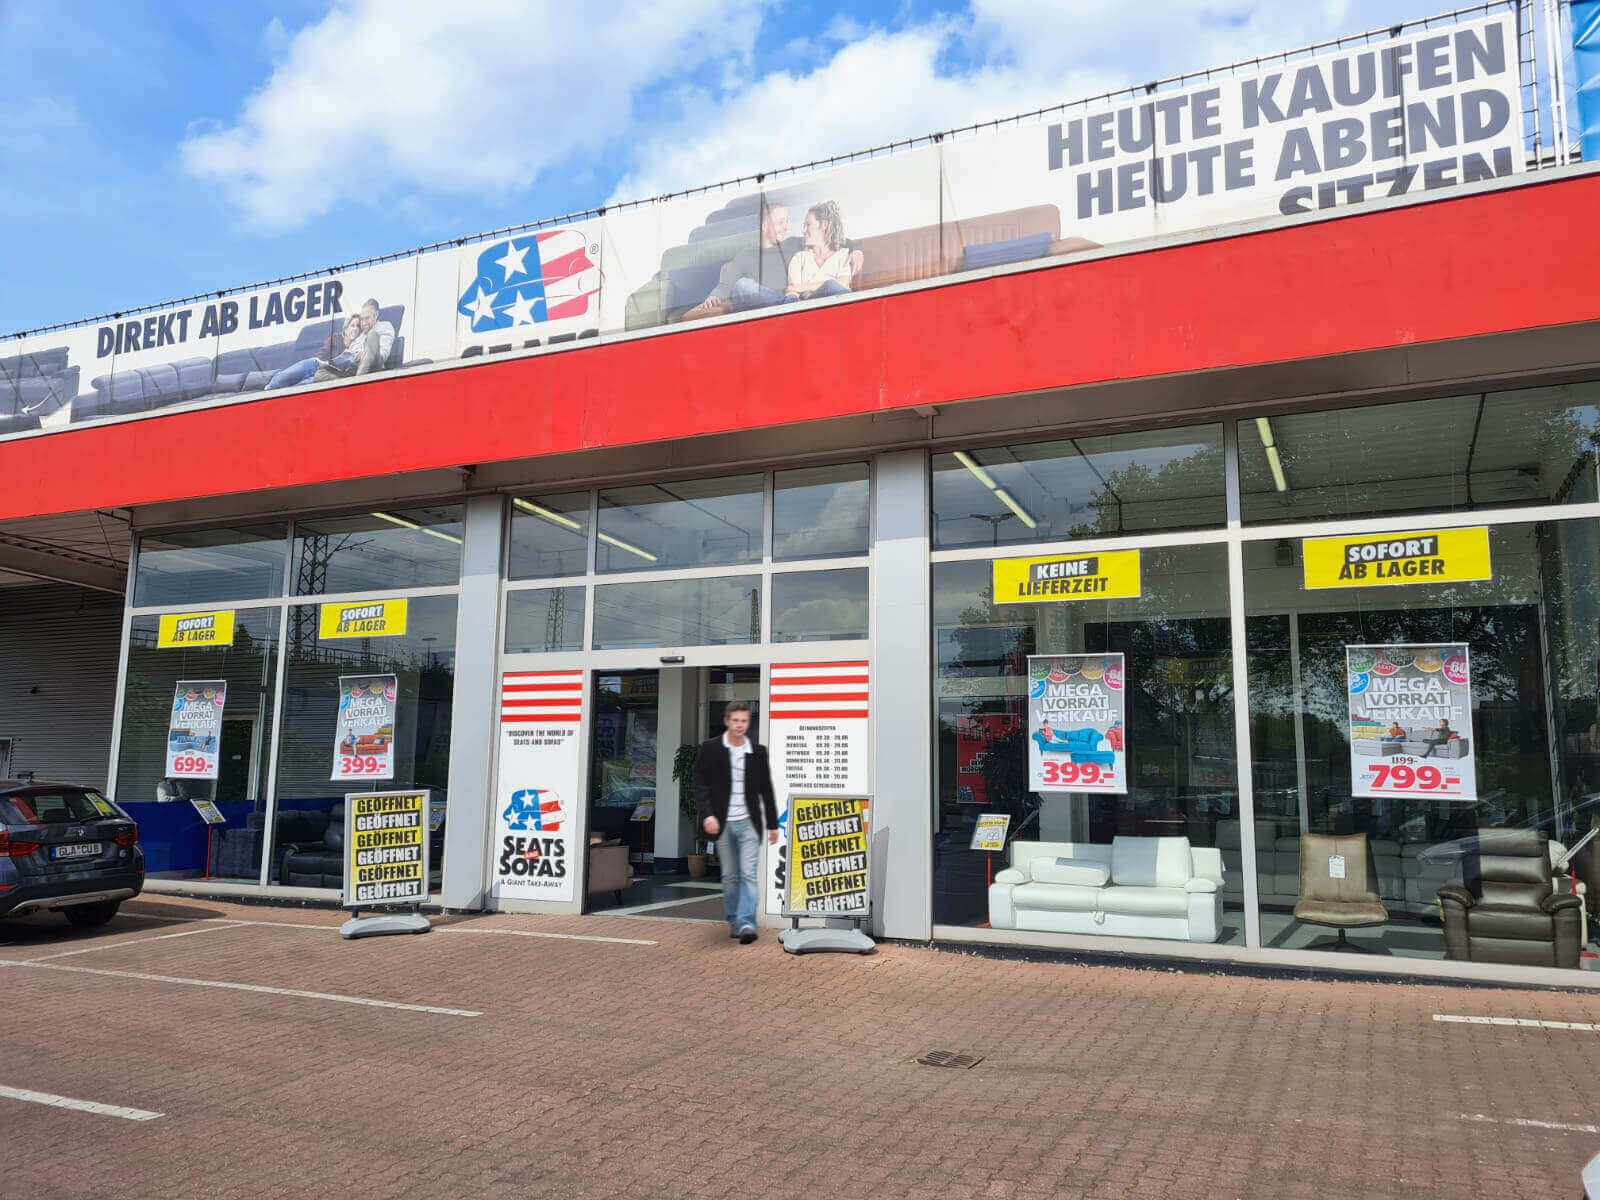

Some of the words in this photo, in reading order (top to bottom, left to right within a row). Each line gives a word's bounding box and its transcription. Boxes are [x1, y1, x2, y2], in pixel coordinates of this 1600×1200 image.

[1048, 88, 1221, 171] HEUTE
[1241, 22, 1506, 129] KAUFEN
[1077, 138, 1255, 219] HEUTE
[1275, 89, 1510, 181] ABEND
[97, 310, 192, 358] DIREKT
[199, 301, 239, 339] AB
[249, 281, 343, 329] LAGER
[1348, 538, 1433, 562] SOFORT
[1037, 560, 1088, 579] KEINE
[1339, 563, 1367, 580] AB
[1376, 559, 1445, 578] LAGER
[1019, 577, 1108, 596] LIEFERZEIT
[342, 605, 383, 621] SOFORT
[178, 616, 214, 631] SOFORT
[336, 622, 350, 632] AB
[353, 620, 386, 632] LAGER
[172, 632, 185, 641] AB
[188, 630, 215, 641] LAGER
[1048, 684, 1102, 696] MEGA
[1372, 677, 1443, 691] MEGA
[184, 701, 213, 711] MEGA
[350, 697, 383, 707] MEGA
[1045, 696, 1106, 710] VORRAT
[1369, 692, 1448, 706] VORRAT
[181, 711, 213, 719] VORRAT
[347, 707, 384, 717] VORRAT
[1036, 710, 1118, 721] VERKAUF
[1357, 706, 1463, 721] VERKAUF
[176, 719, 217, 728] VERKAUF
[341, 716, 391, 728] VERKAUF
[174, 756, 214, 772] 699.-
[341, 757, 387, 774] 399.-
[1043, 761, 1115, 783] 399.-
[1368, 764, 1461, 790] 799.-
[357, 796, 417, 813] GEÖFFNET
[797, 800, 856, 821] GEÖFFNET
[357, 813, 418, 830] GEÖFFNET
[799, 817, 859, 840] GEÖFFNET
[357, 830, 417, 847] GEÖFFNET
[503, 835, 565, 857] SEATS
[358, 846, 419, 865] GEÖFFNET
[801, 837, 860, 858] GEÖFFNET
[359, 864, 419, 882] GEÖFFNET
[499, 856, 566, 878] SOFAS
[804, 855, 864, 878] GEÖFFNET
[358, 881, 420, 900] GEÖFFNET
[807, 873, 866, 895] GEÖFFNET
[808, 892, 864, 911] GEÖFFNE
